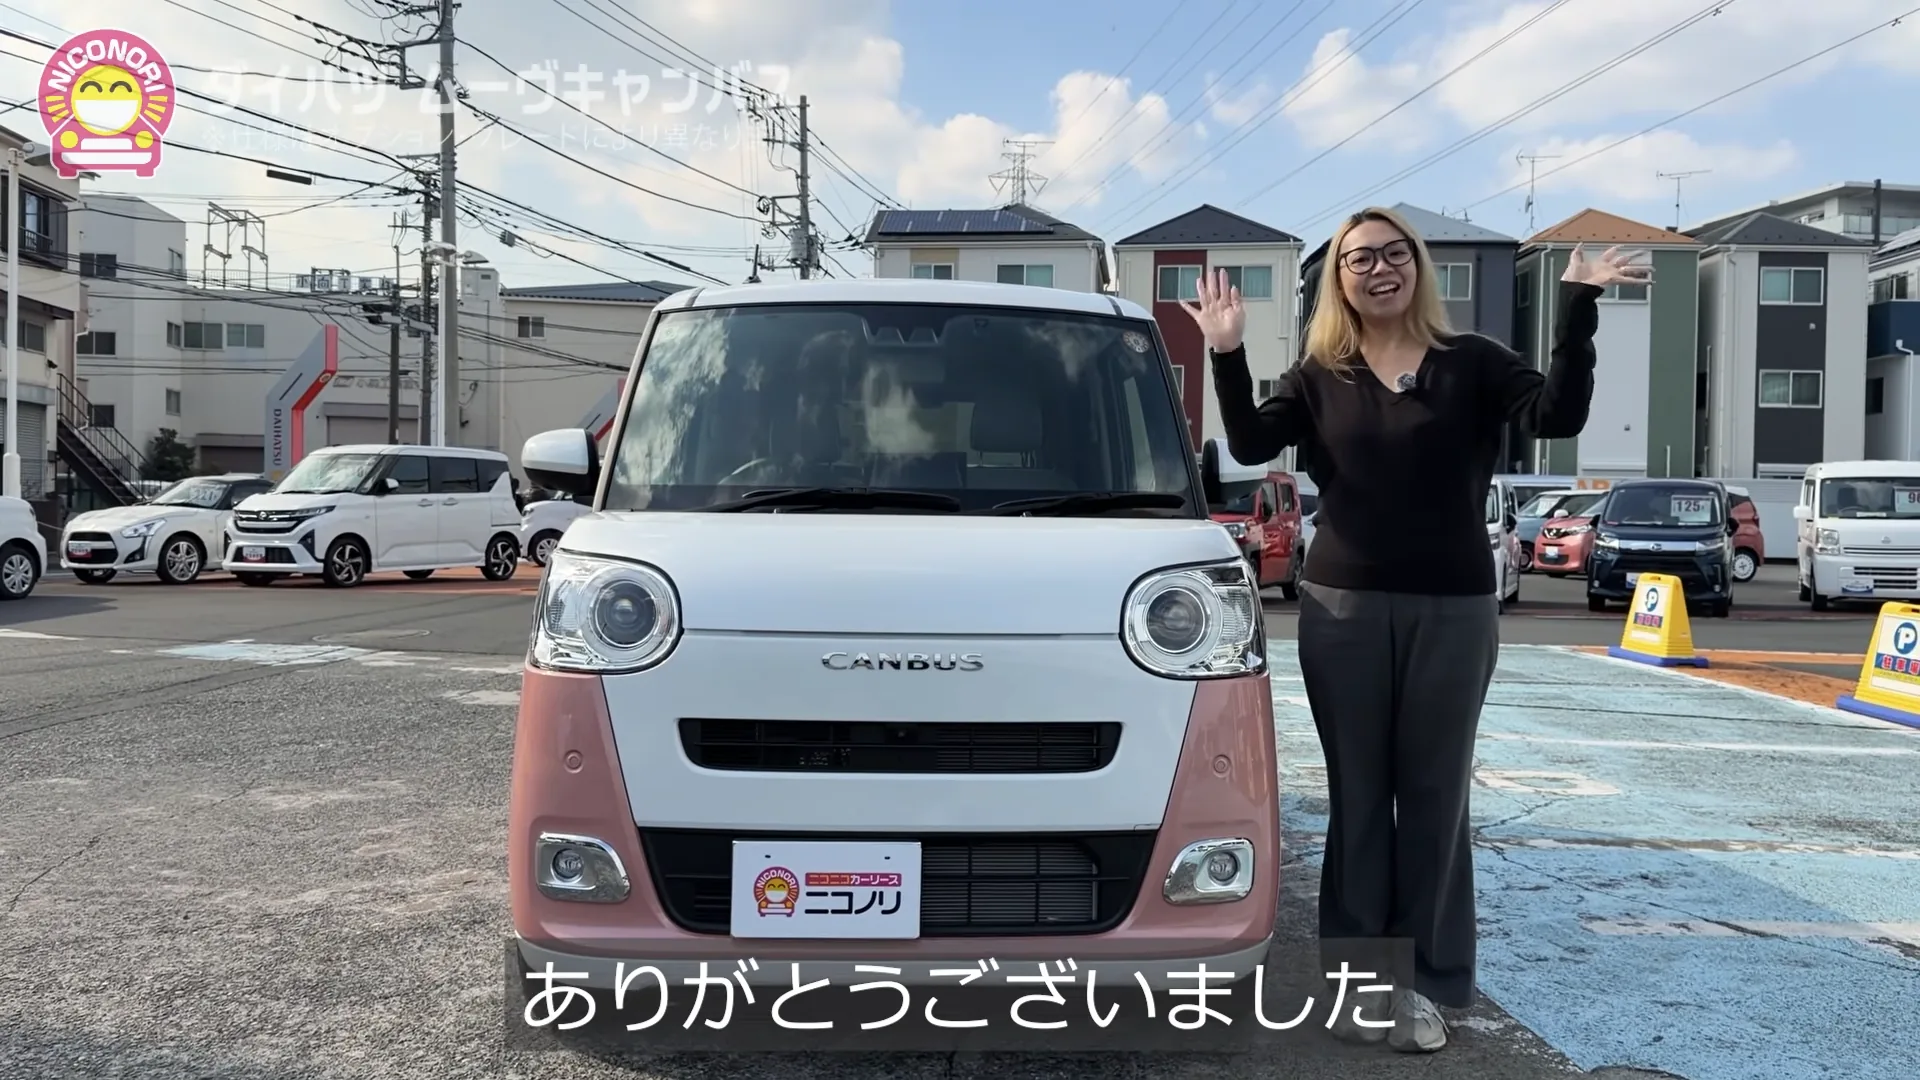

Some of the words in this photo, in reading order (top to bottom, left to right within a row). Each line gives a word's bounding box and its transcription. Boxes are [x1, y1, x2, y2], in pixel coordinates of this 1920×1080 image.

[273, 408, 282, 466] DAIHATSU
[1676, 501, 1700, 512] 125
[821, 651, 984, 672] CANBUS
[756, 869, 797, 889] NICONORI
[808, 874, 900, 886] ニコニコカーリース
[804, 890, 901, 915] ニコノリ
